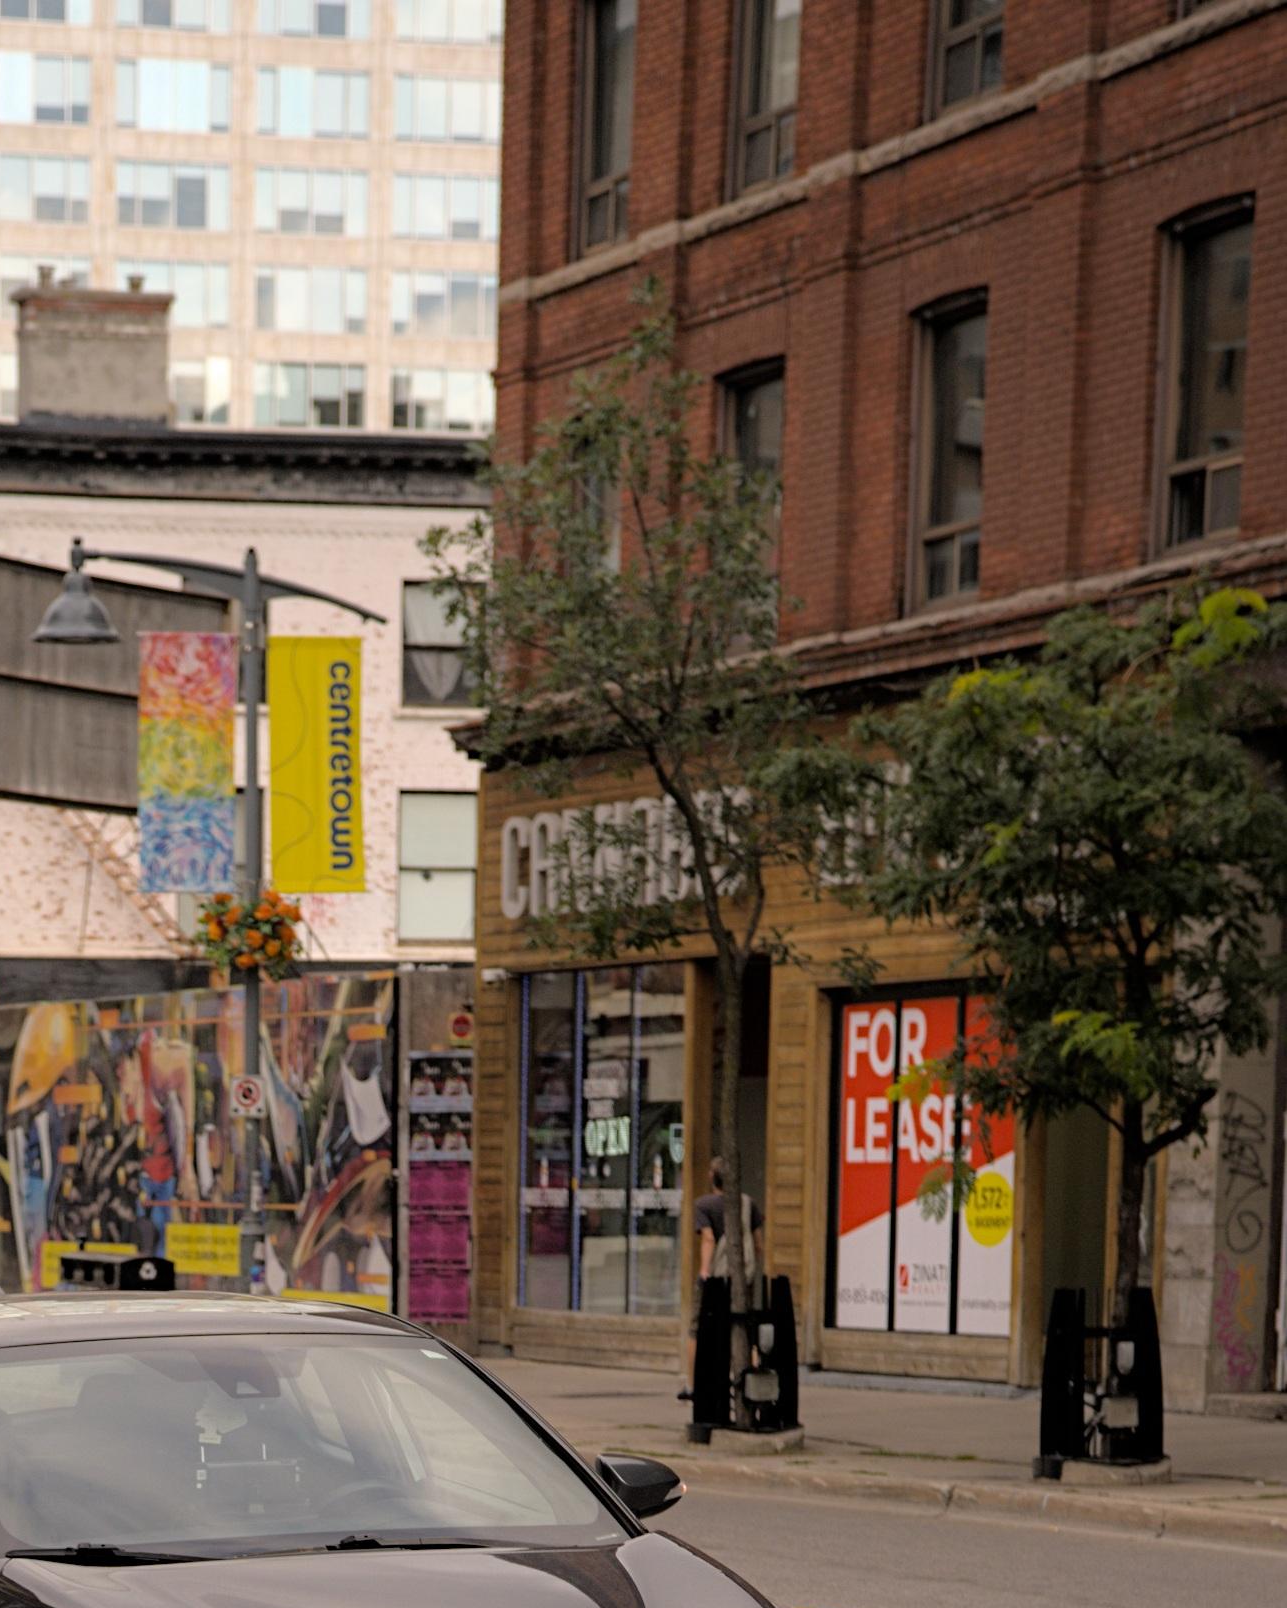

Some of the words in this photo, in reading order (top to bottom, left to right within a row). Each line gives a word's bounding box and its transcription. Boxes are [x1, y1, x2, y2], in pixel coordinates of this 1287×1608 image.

[329, 661, 354, 870] centretown
[847, 1008, 927, 1078] FOR
[585, 1117, 630, 1157] OPEN
